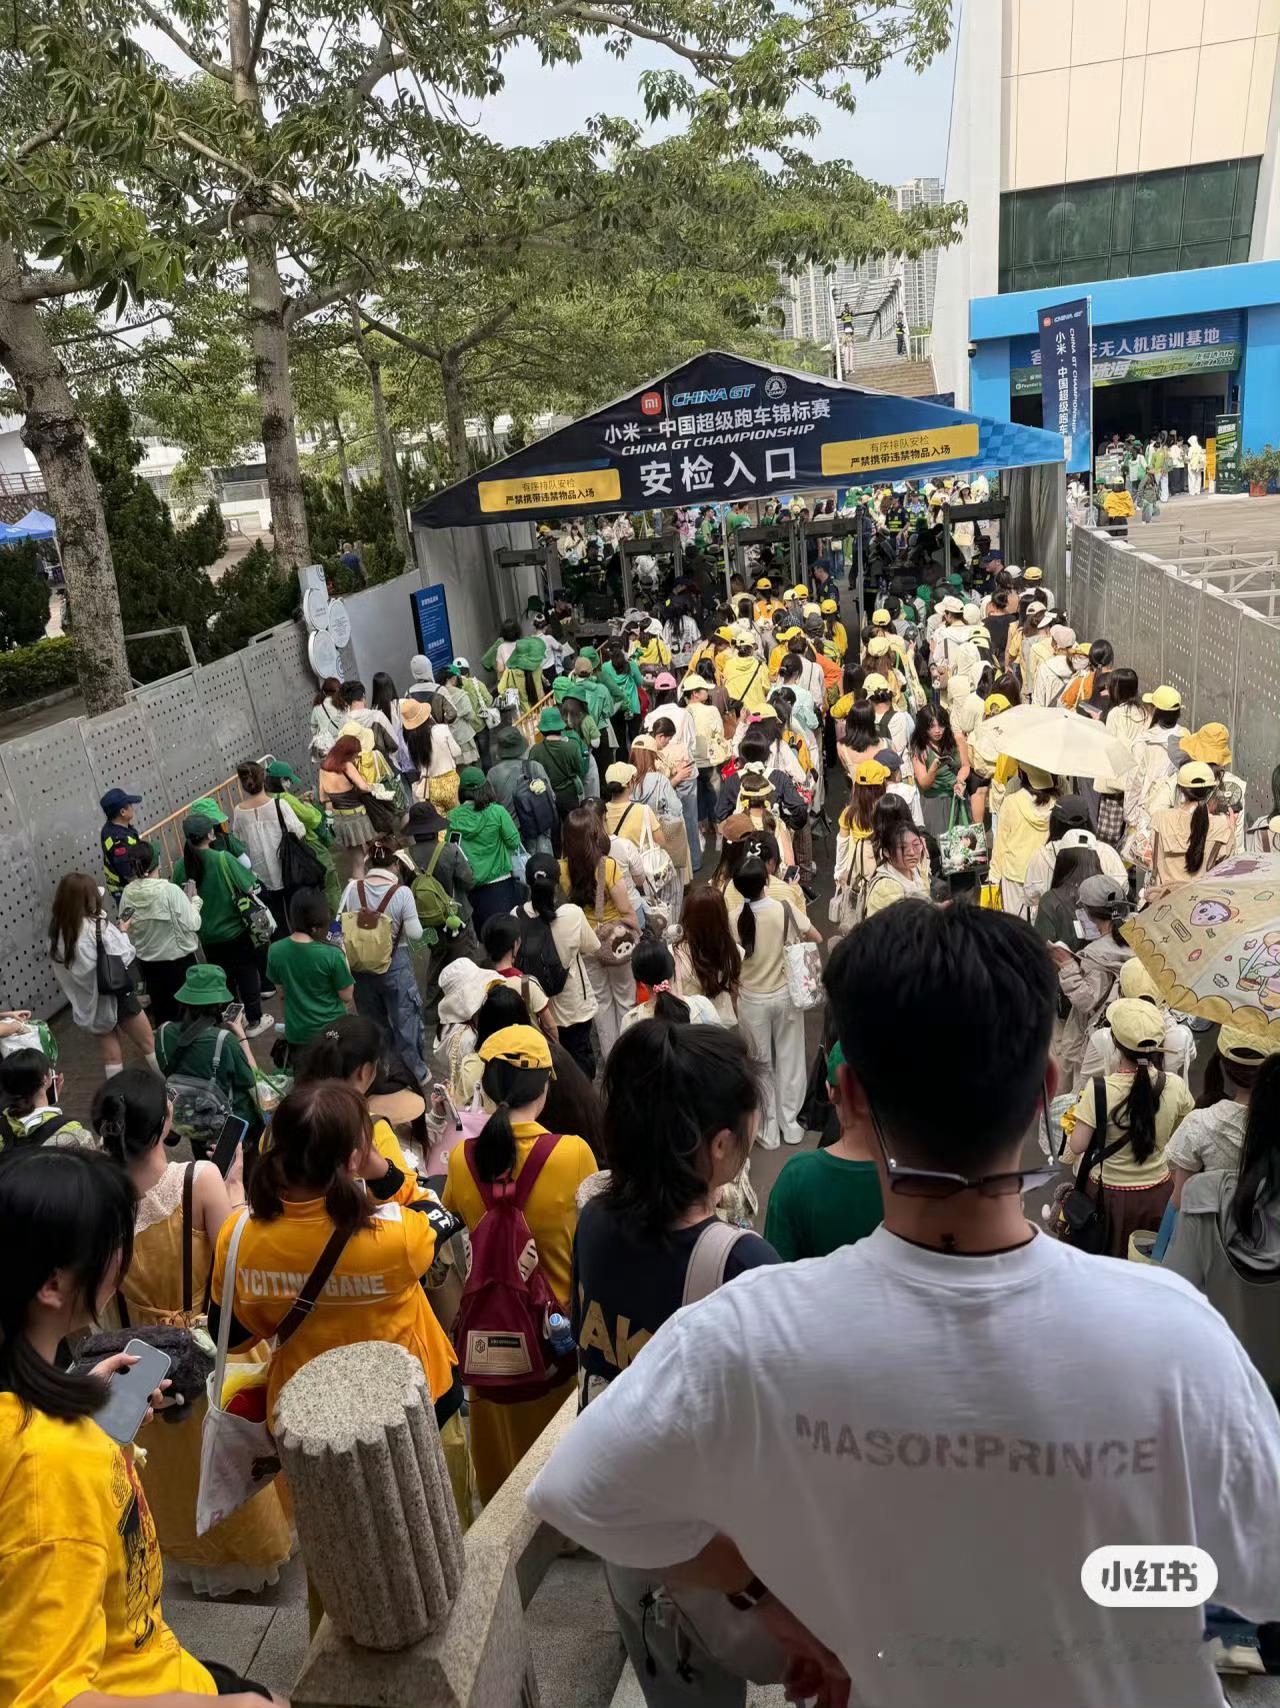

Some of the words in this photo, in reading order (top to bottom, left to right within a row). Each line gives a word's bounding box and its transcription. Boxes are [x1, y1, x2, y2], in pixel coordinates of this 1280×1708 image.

[672, 387, 728, 407] CHINA
[729, 384, 756, 399] GT
[621, 441, 668, 456] CHINA
[671, 438, 693, 450] GT
[693, 423, 815, 448] CHAMPIONSHIP
[850, 444, 952, 468] 严禁携带违禁物品入场
[639, 447, 797, 497] 安检入口
[505, 487, 596, 505] 严禁携带违禁物品入场
[796, 1413, 1158, 1481] MASONPRINCE
